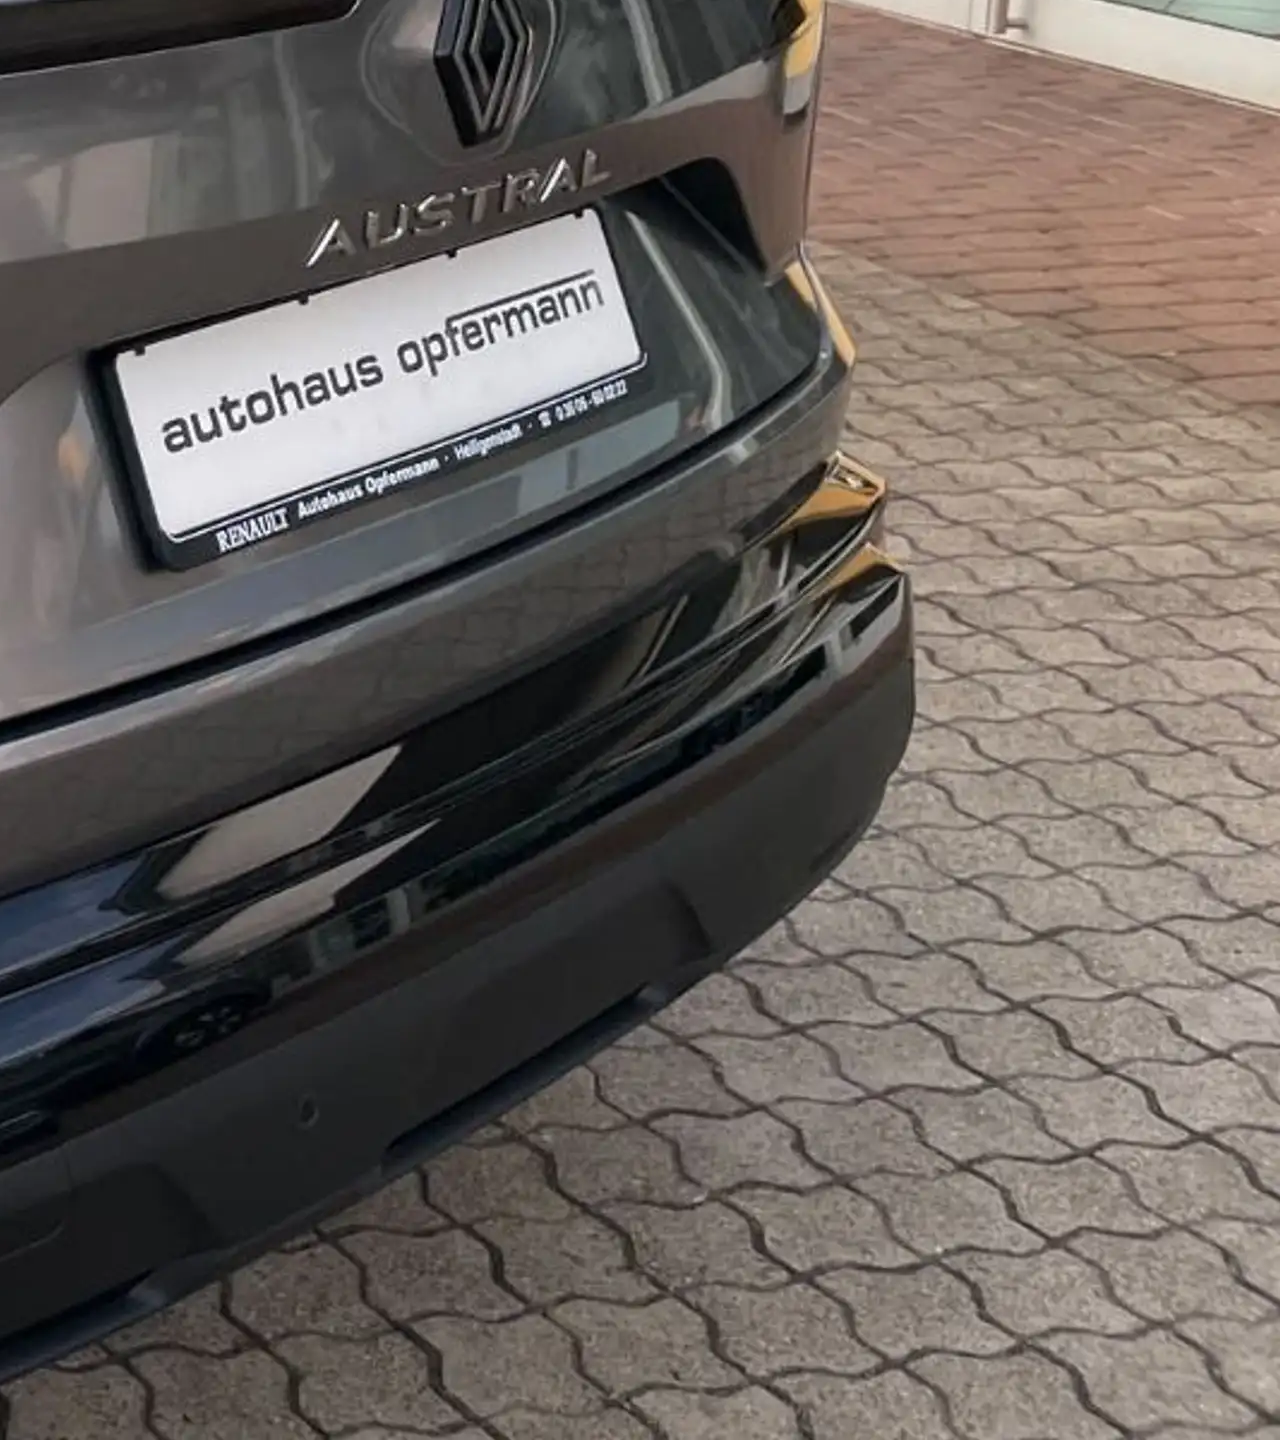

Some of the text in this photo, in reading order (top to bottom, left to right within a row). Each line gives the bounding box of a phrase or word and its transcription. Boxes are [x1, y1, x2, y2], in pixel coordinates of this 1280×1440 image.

[305, 148, 611, 268] AUSTRAL
[160, 269, 606, 453] autohaus opfermann
[215, 507, 290, 552] RENAULT
[297, 484, 364, 520] Autohaus
[364, 456, 439, 495] Opfermann
